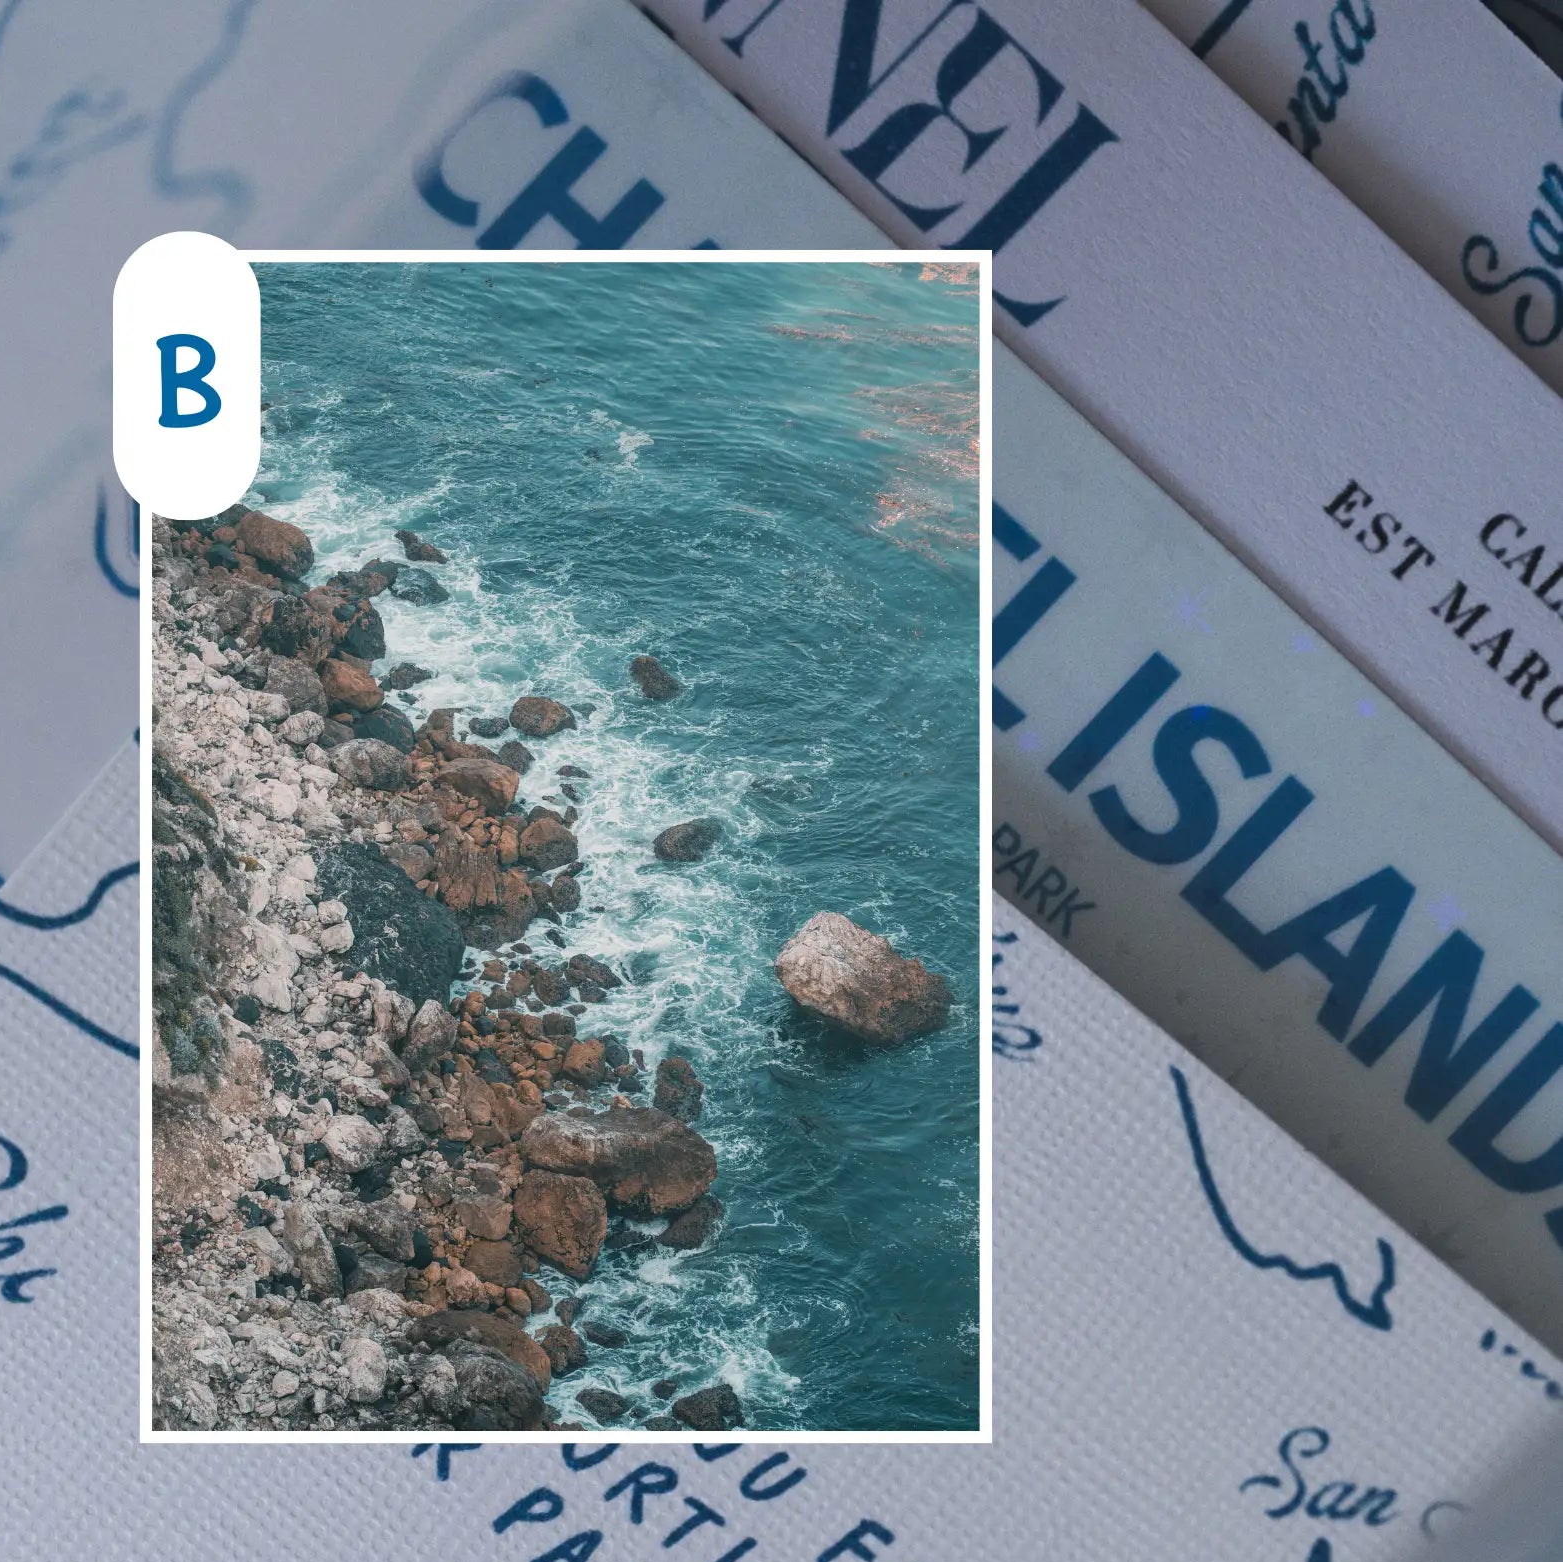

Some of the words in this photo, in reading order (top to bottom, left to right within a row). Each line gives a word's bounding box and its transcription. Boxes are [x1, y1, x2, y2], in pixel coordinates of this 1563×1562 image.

[1323, 478, 1436, 581] EST
[1479, 512, 1563, 620] CAL
[1046, 650, 1563, 1260] ISLAND
[1240, 1426, 1400, 1527] San
